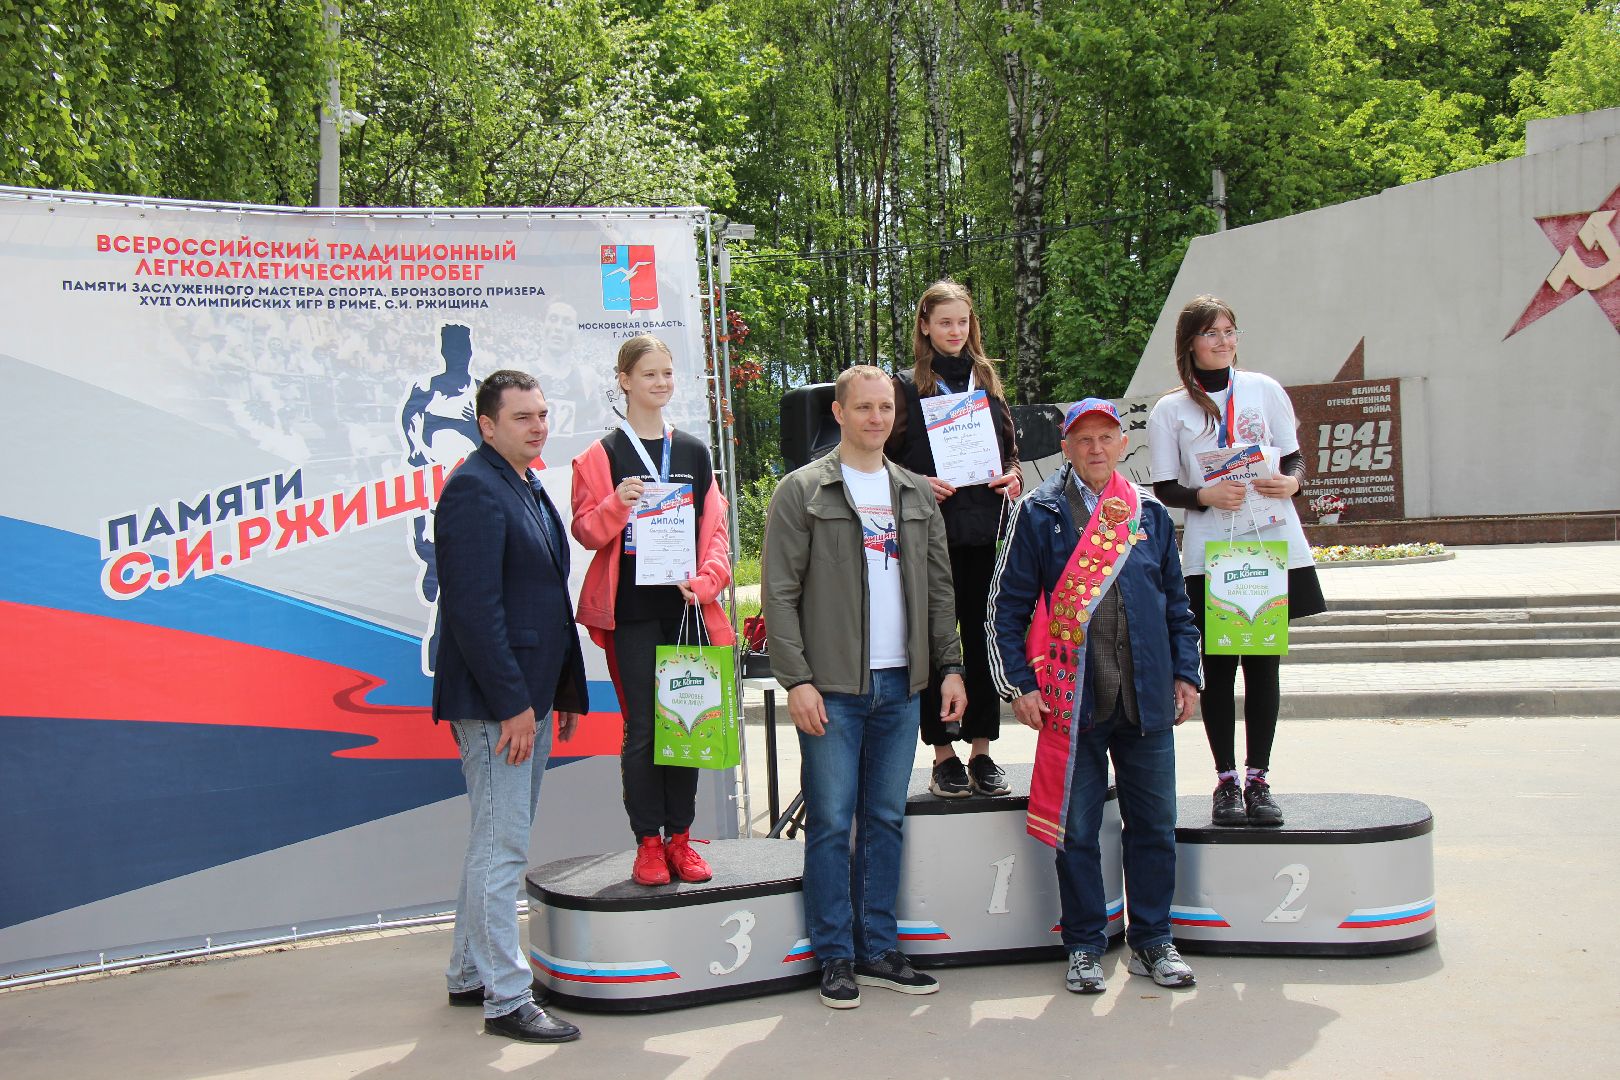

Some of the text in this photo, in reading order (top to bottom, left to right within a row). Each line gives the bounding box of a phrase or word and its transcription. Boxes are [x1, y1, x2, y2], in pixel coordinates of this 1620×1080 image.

[97, 234, 516, 263] ВСЕРОССИЙСКИЙ ТРАДИЦИОННЫЙ
[135, 258, 485, 281] ЛЕГКОАТЛЕТИЧЕСКИЙ ПРОБЕГ
[62, 280, 127, 292] ПАМЯТИ
[132, 283, 254, 297] ЗАСЛУЖЕННОГО
[258, 286, 324, 297] МАСТЕРА
[391, 287, 483, 298] БРОНЗОВОГО
[486, 286, 545, 297] ПРИЗЕРА
[140, 296, 171, 306] XVII
[176, 296, 291, 309] ОЛИМПИЙСКИХ
[296, 299, 323, 309] ИГР
[328, 299, 336, 309] В
[384, 299, 412, 309] С.И.
[416, 299, 489, 311] РЖИЩИНА
[578, 321, 640, 330] МОСКОВСКАЯ
[1352, 385, 1391, 395] ВЕЛИКАЯ
[1327, 395, 1391, 407] ОТЕЧЕСТВЕННАЯ
[1363, 404, 1391, 414] ВОЙНА
[943, 421, 981, 434] ДИПЛОМ
[1318, 421, 1392, 448] 1941
[1317, 446, 1392, 473] 1945
[1311, 477, 1348, 486] 25-ЛЕТИЯ
[1350, 475, 1394, 484] РАЗГРОМА
[1303, 485, 1394, 496] НЕМЕЦКО-ФАШИСТСКИХ
[1355, 494, 1395, 504] МОСКВОЙ
[107, 468, 303, 552] ПАМЯТИ
[651, 517, 685, 525] ДИПЛОМ
[1226, 572, 1239, 581] Dr.
[989, 854, 1015, 915] 1
[1261, 863, 1310, 924] 2
[709, 910, 756, 976] 3
